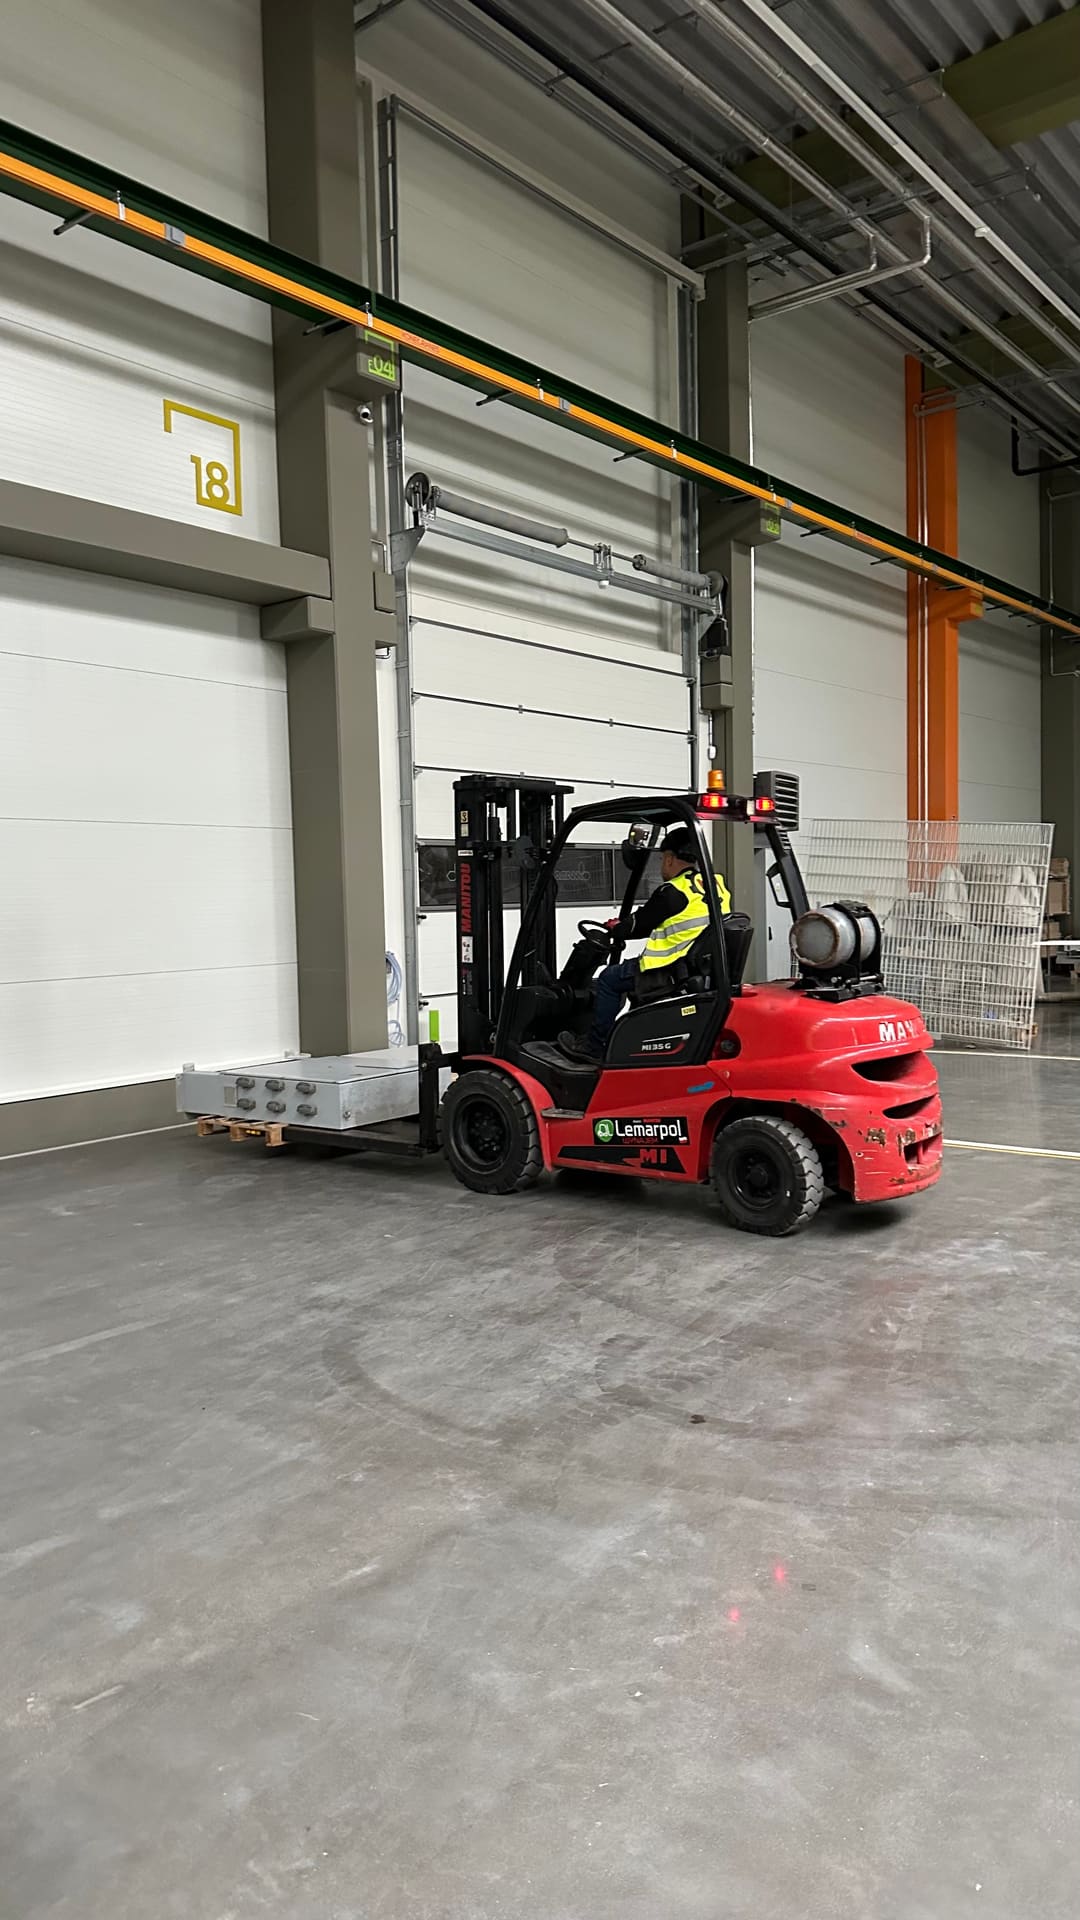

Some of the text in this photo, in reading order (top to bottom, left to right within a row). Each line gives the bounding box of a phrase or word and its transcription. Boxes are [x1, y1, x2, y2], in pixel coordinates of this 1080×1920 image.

[190, 454, 230, 506] 18
[460, 863, 471, 932] MANITOU
[615, 1119, 682, 1140] Lemarpol
[640, 1149, 667, 1164] MI
